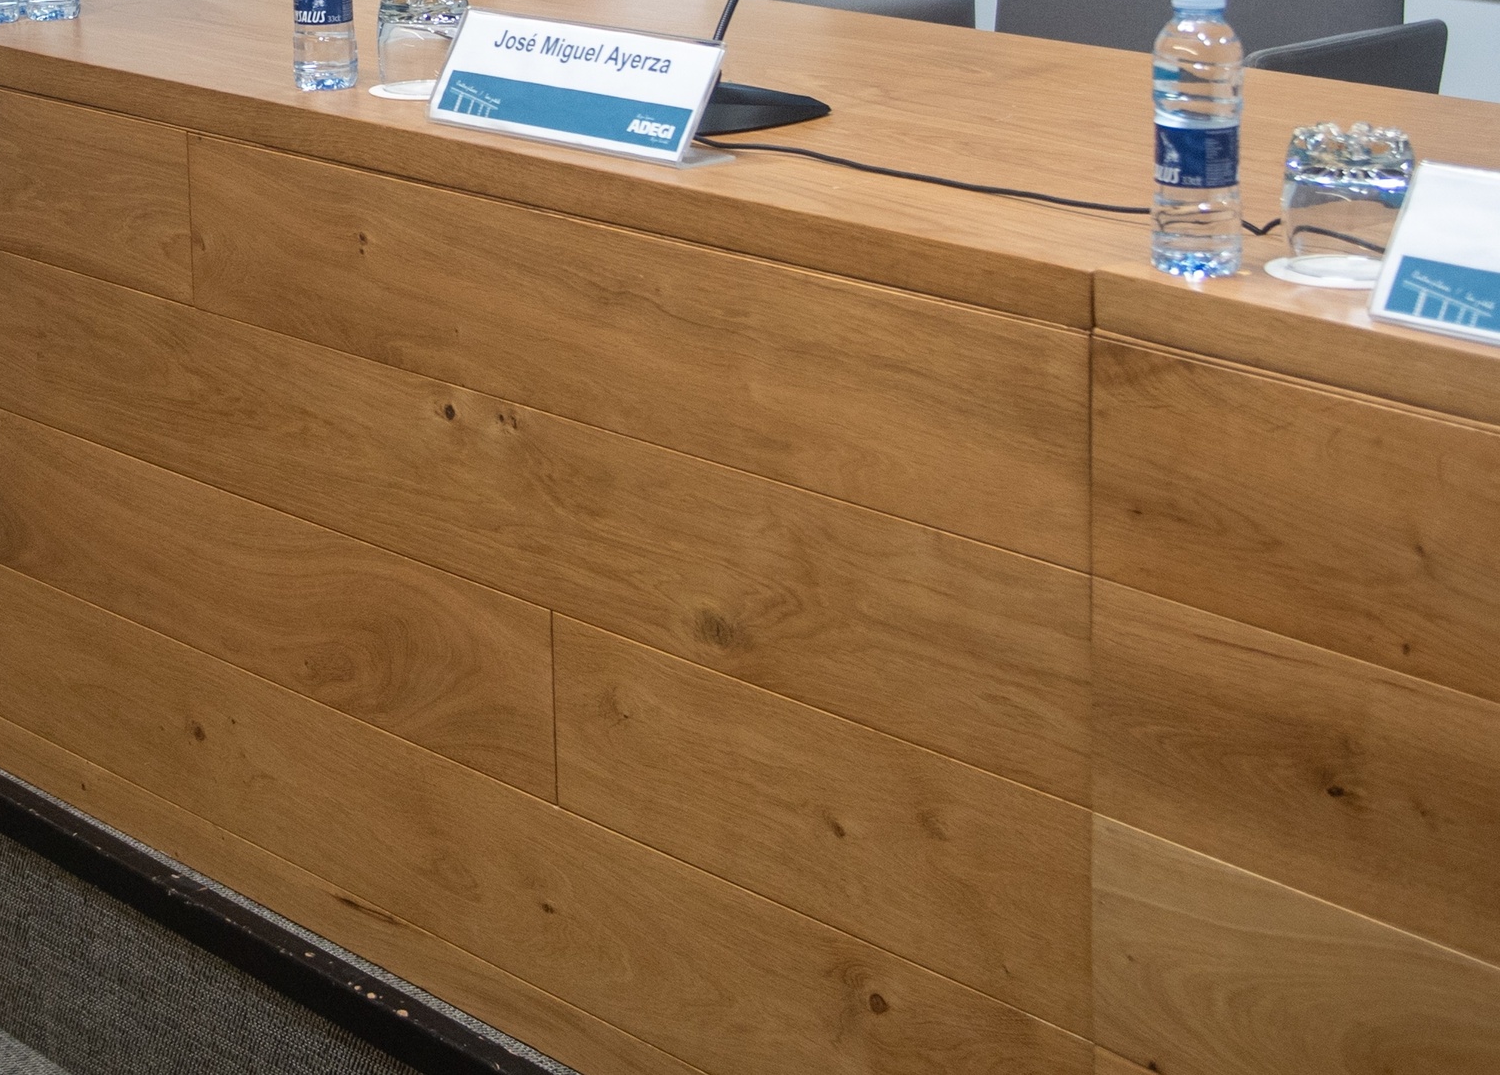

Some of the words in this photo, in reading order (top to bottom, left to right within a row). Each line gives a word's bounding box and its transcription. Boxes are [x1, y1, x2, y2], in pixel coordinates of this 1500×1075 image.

[294, 11, 326, 23] SALUS
[493, 29, 537, 53] José
[539, 35, 604, 64] Miguel
[603, 45, 673, 75] Ayerza
[626, 119, 676, 139] ADEGI
